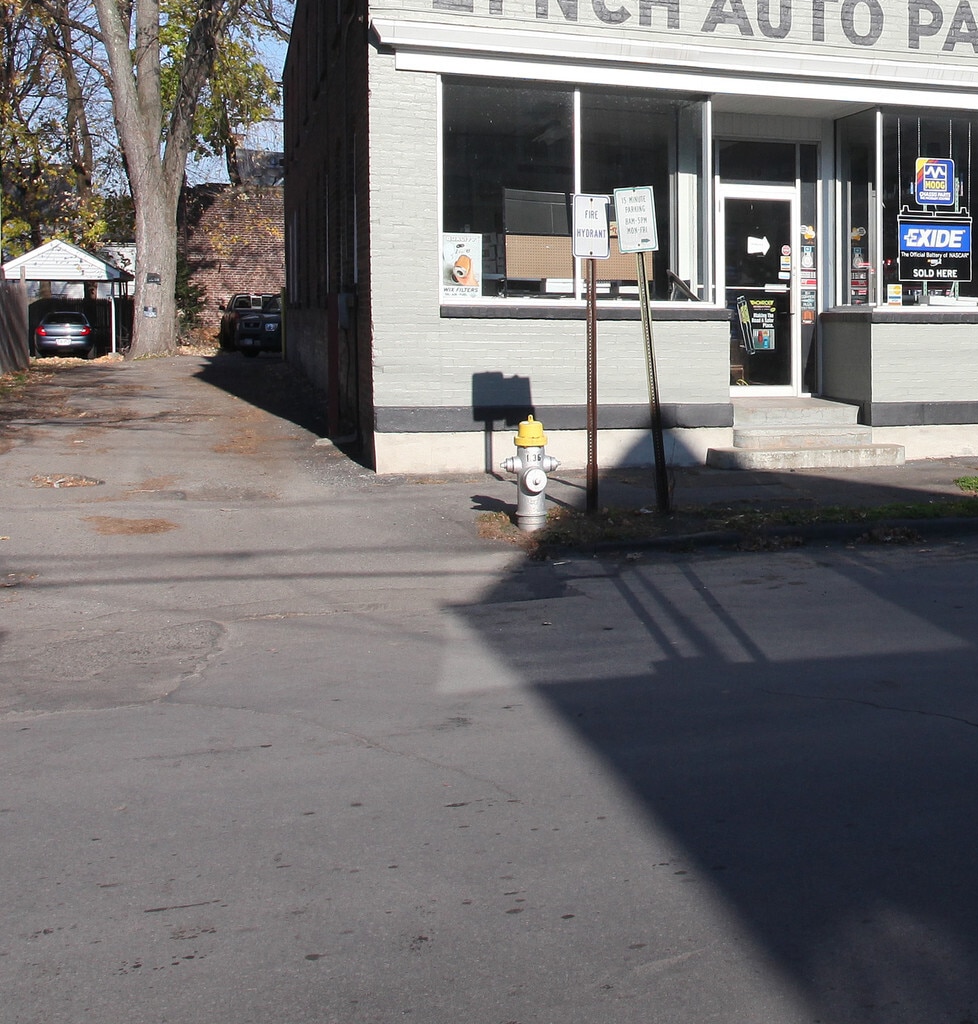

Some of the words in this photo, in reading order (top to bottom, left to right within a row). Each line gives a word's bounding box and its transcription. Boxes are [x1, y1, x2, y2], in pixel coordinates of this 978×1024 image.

[925, 180, 945, 190] MOOG
[629, 196, 646, 204] MINUTE
[584, 210, 598, 219] FIRE
[624, 206, 646, 214] PARKING
[577, 228, 606, 238] HYDRANT
[903, 228, 964, 248] EXIDE
[912, 268, 935, 278] SOLD
[936, 269, 958, 278] HERE
